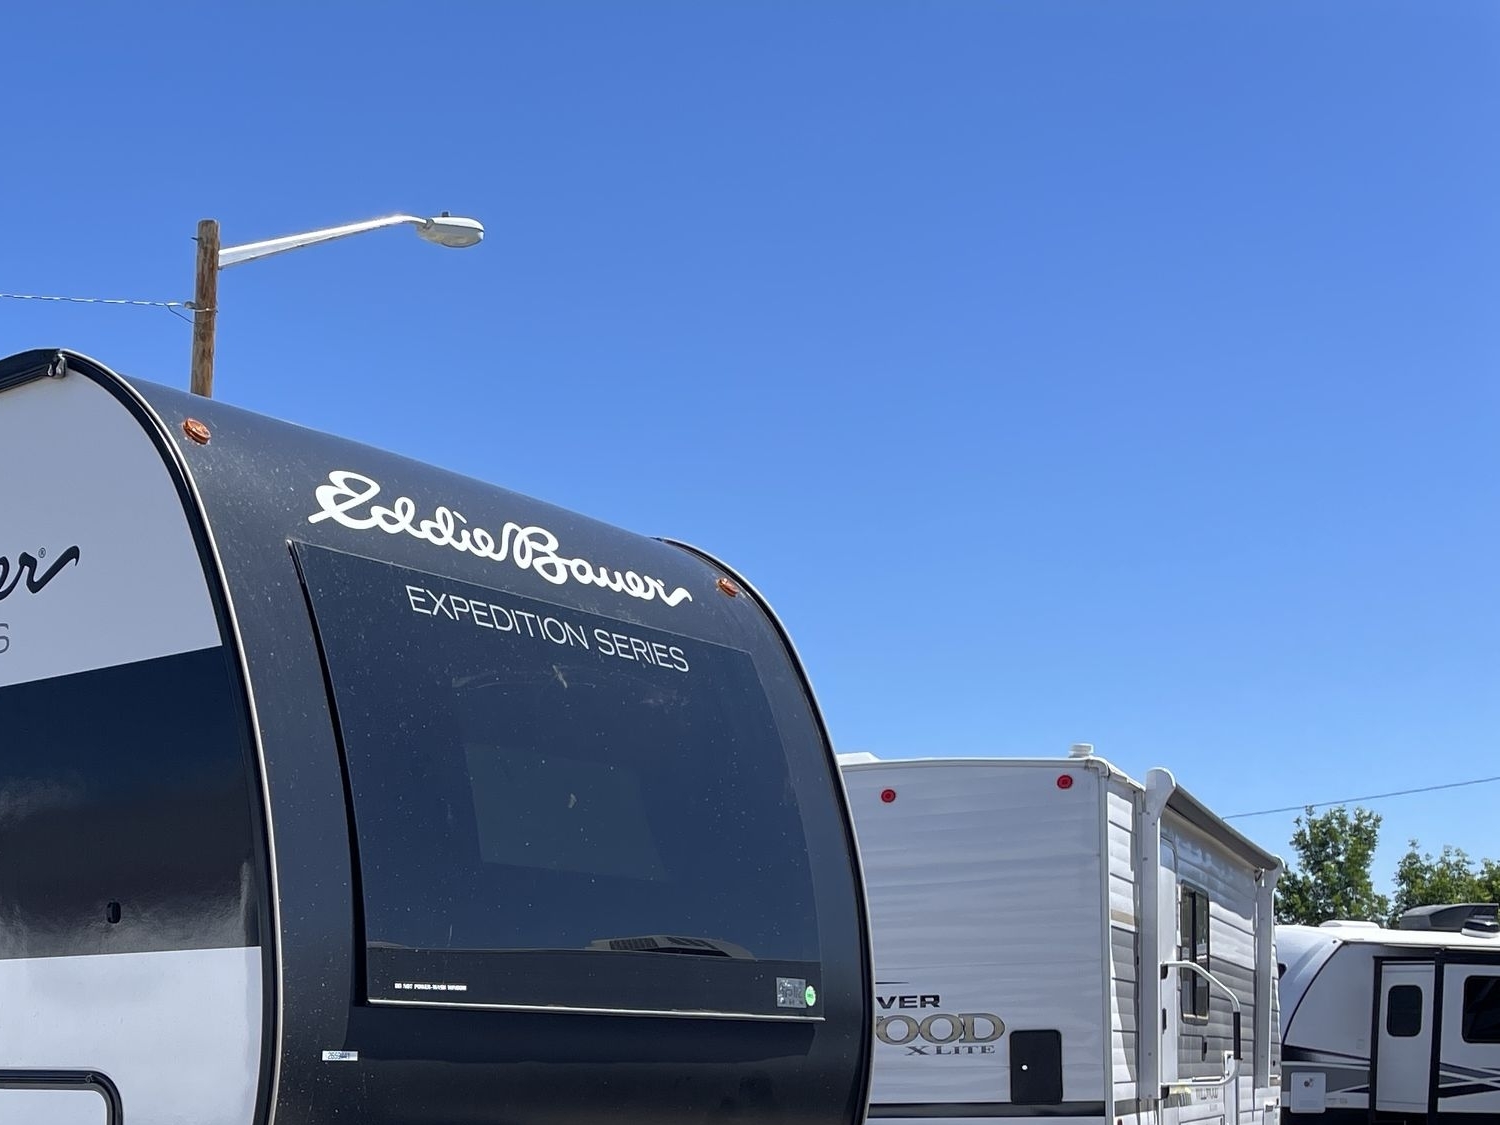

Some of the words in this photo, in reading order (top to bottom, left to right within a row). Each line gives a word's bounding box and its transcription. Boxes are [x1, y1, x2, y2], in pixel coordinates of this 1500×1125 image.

[308, 470, 504, 561] Eddie
[405, 584, 591, 651] EXPEDITION
[592, 628, 691, 673] SERIES
[876, 994, 941, 1009] VER
[876, 1012, 1006, 1046] OOD
[935, 1044, 996, 1056] LITE
